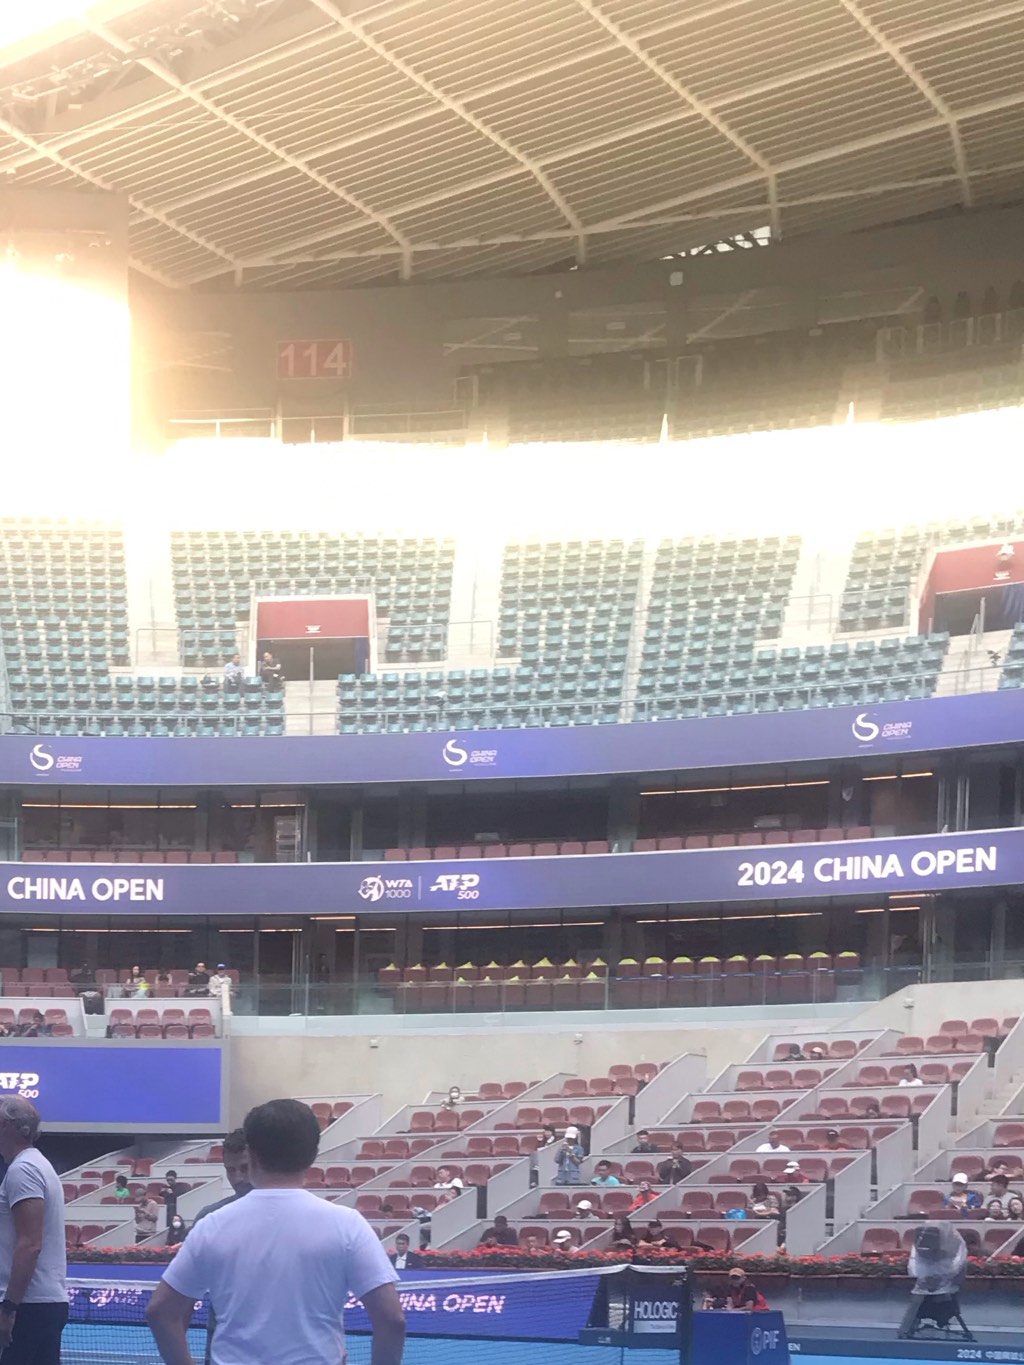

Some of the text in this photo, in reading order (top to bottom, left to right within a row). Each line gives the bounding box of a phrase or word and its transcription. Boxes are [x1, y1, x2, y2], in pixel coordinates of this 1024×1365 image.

[280, 342, 347, 377] 114
[737, 846, 997, 886] 2024 CHINA OPEN
[7, 876, 86, 900] CHINA
[91, 878, 164, 901] OPEN
[385, 879, 413, 888] WTA
[429, 874, 480, 892] ATP
[385, 889, 411, 899] 1000
[457, 890, 480, 900] 500
[18, 1089, 40, 1099] 500
[442, 1293, 505, 1313] OPEN
[634, 1300, 679, 1319] HOLOGIC
[763, 1330, 780, 1350] PIF
[787, 1342, 801, 1351] EN
[957, 1348, 982, 1359] 2024
